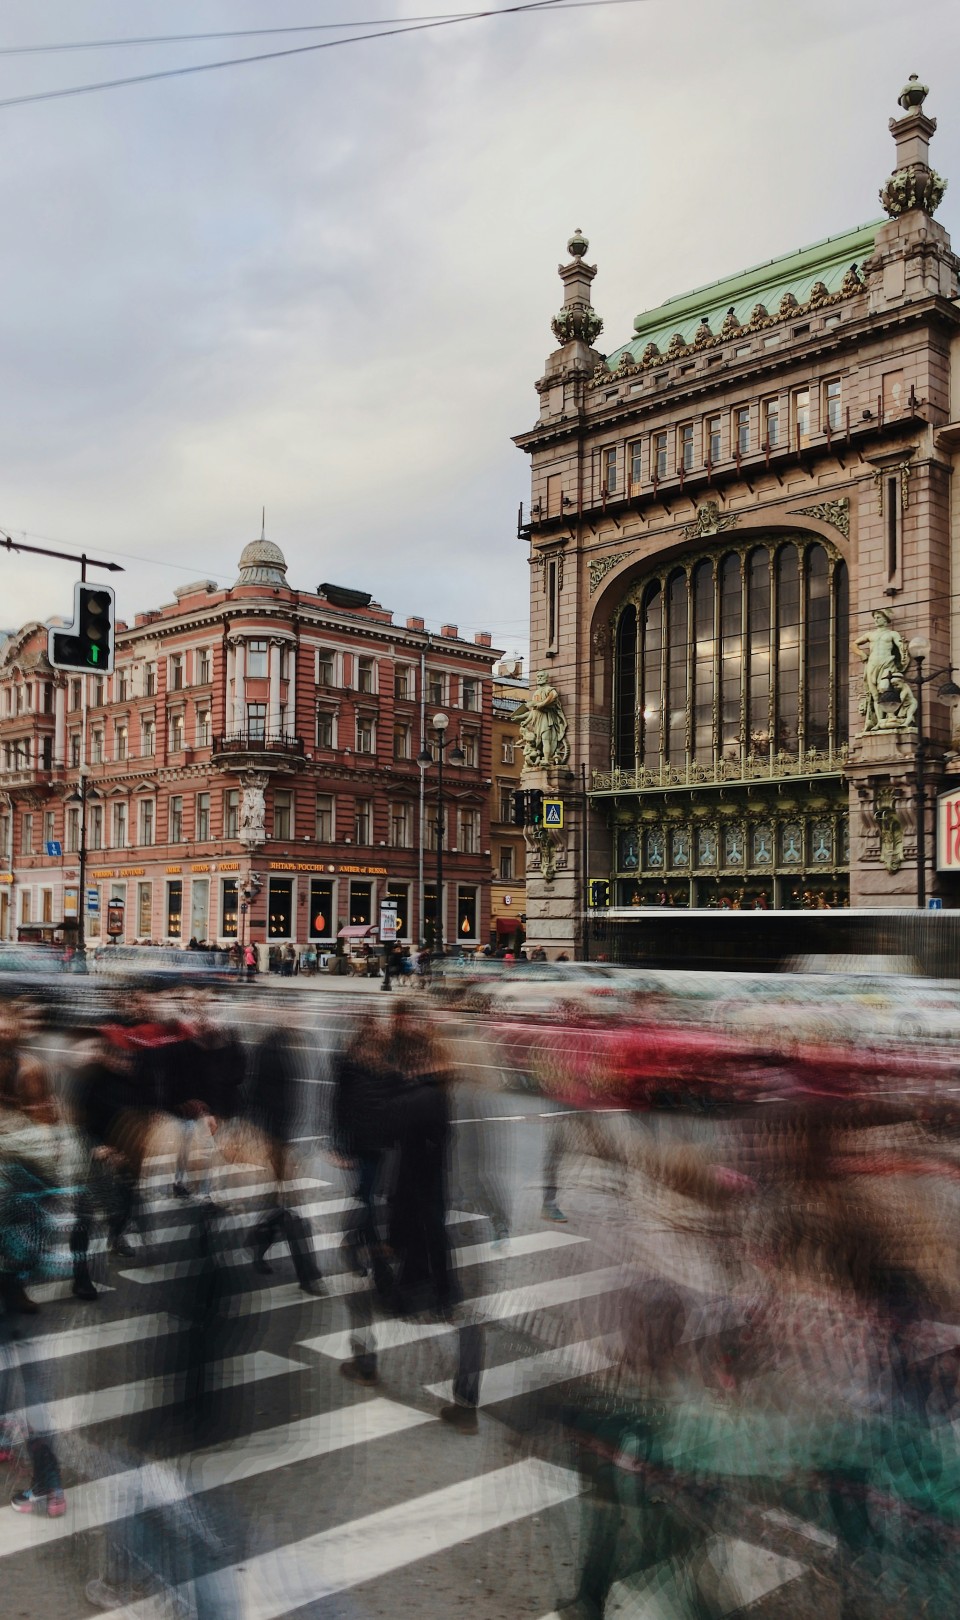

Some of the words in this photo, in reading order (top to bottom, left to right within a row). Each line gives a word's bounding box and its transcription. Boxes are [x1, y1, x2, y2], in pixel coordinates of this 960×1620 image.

[218, 862, 240, 871] РОССИИ
[270, 862, 296, 870] ЯНТАРЬ
[297, 863, 324, 871] РОССИИ
[368, 866, 388, 874] RUSSIA
